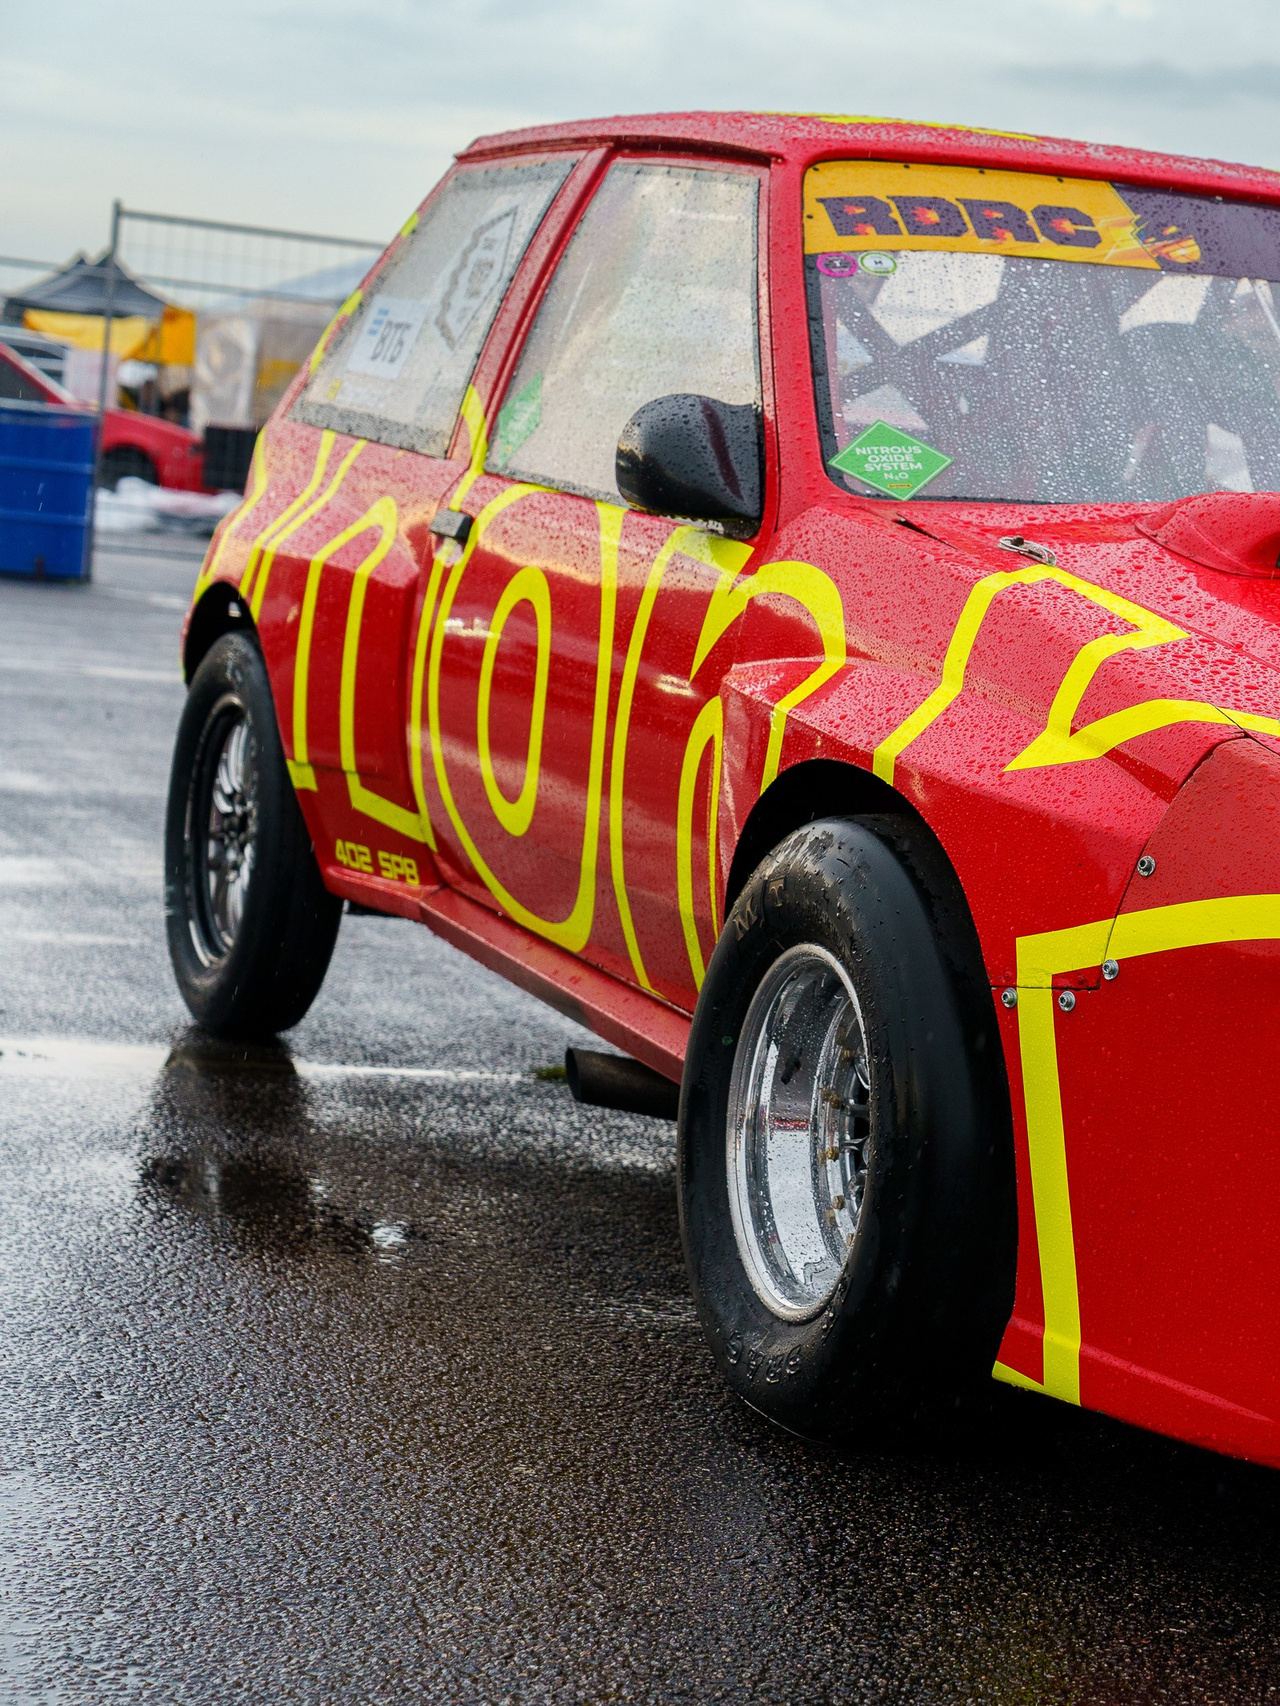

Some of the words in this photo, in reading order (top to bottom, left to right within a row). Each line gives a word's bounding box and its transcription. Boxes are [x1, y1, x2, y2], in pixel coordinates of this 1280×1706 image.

[815, 195, 1103, 249] RDRC
[855, 445, 923, 456] NITROUS
[867, 453, 915, 464] OXIDE
[864, 461, 923, 472] SYSTEM
[335, 838, 375, 874] 402
[377, 849, 420, 887] SPB
